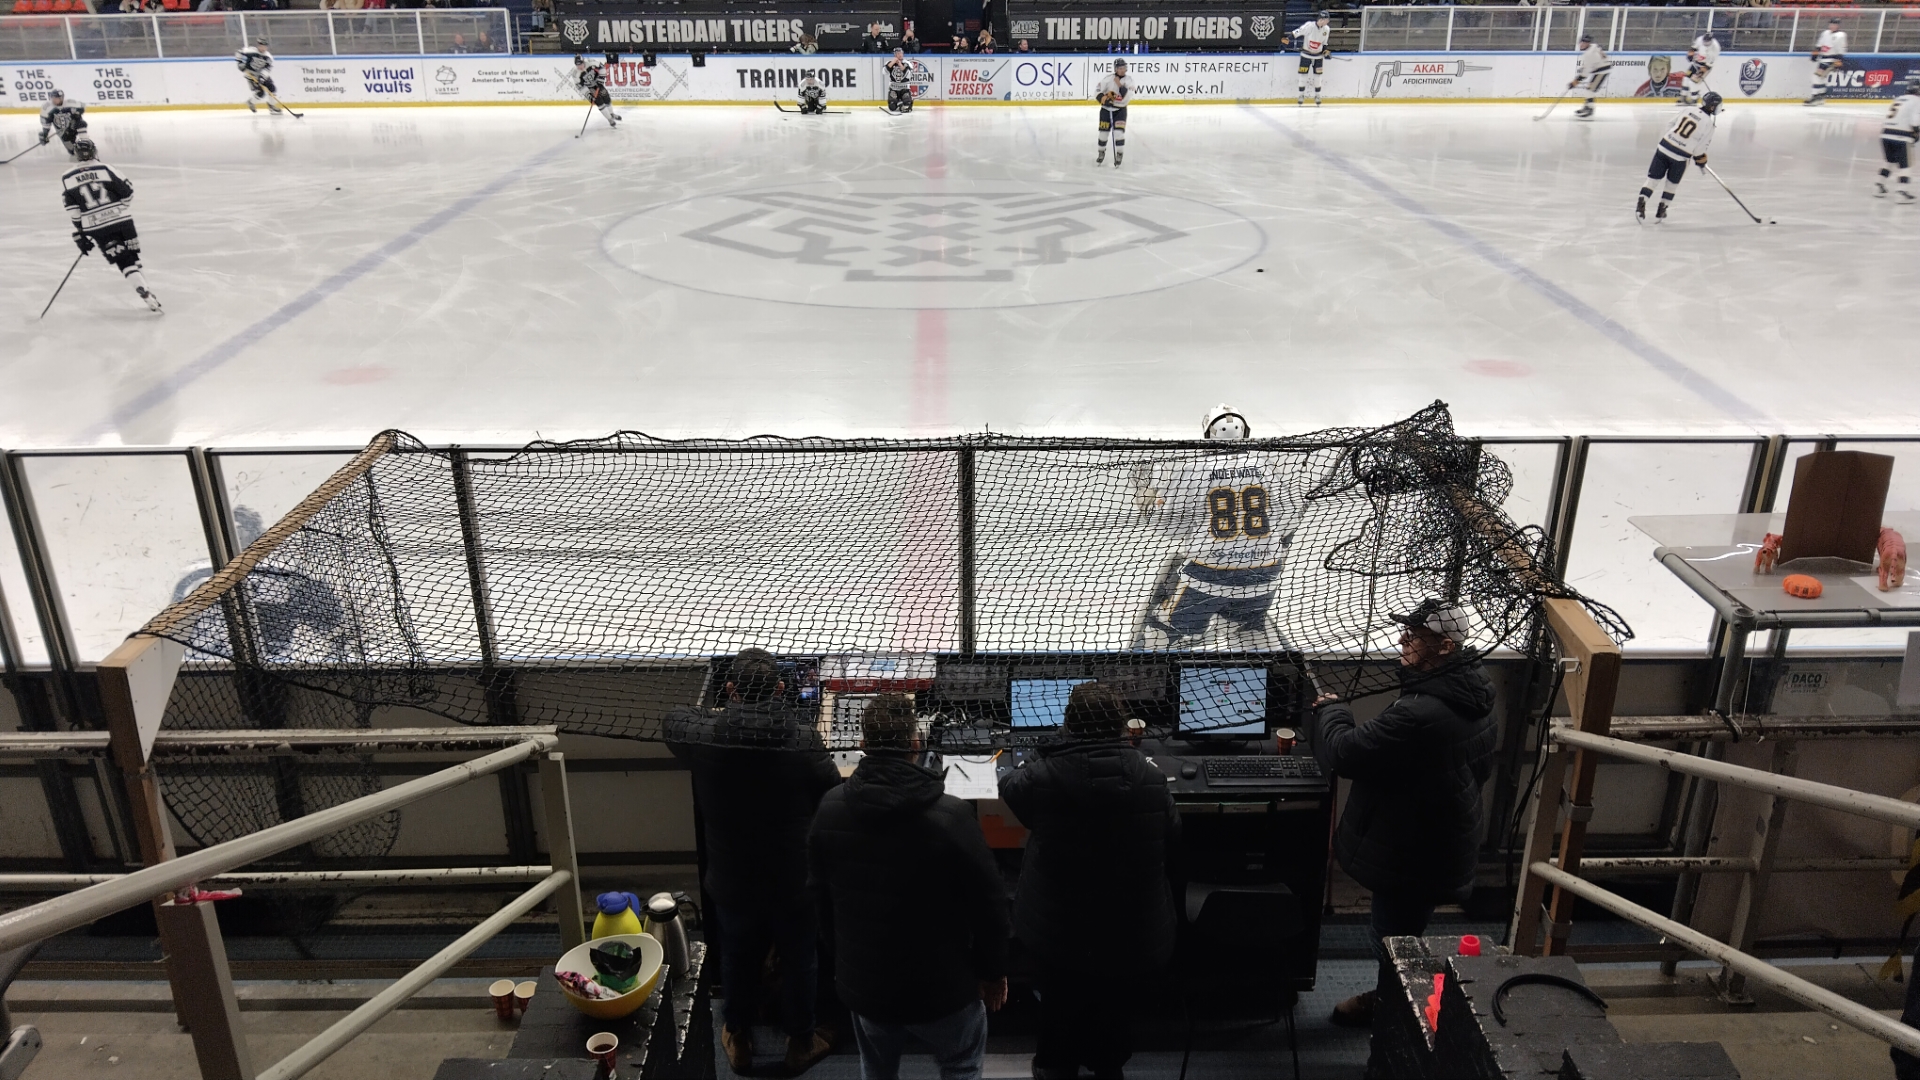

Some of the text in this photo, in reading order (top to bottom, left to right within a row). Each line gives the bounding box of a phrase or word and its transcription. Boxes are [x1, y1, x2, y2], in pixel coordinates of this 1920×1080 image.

[598, 19, 803, 42] AMSTERDAM TIGERS
[1045, 17, 1243, 40] THE HOME OF TIGERS
[362, 67, 414, 80] virtual
[1093, 62, 1269, 73] METERS IN STRAFRECHT
[1413, 64, 1444, 73] AKAR
[604, 62, 652, 87] UIS
[910, 72, 934, 82] RICAN
[950, 69, 978, 82] KING
[1015, 62, 1073, 86] OSK
[1868, 75, 1889, 83] sign
[15, 81, 54, 90] GOOD
[93, 79, 132, 89] GOOD
[304, 85, 347, 94] dealmaking.
[364, 81, 412, 93] vaults
[948, 83, 993, 95] JERSEYS
[1134, 81, 1224, 94] www.osk.nl
[97, 90, 134, 100] BEER
[1673, 116, 1697, 139] 10
[75, 172, 99, 183] KAROL
[79, 182, 112, 209] 17
[1208, 486, 1271, 540] 88
[1791, 673, 1823, 684] DACO
